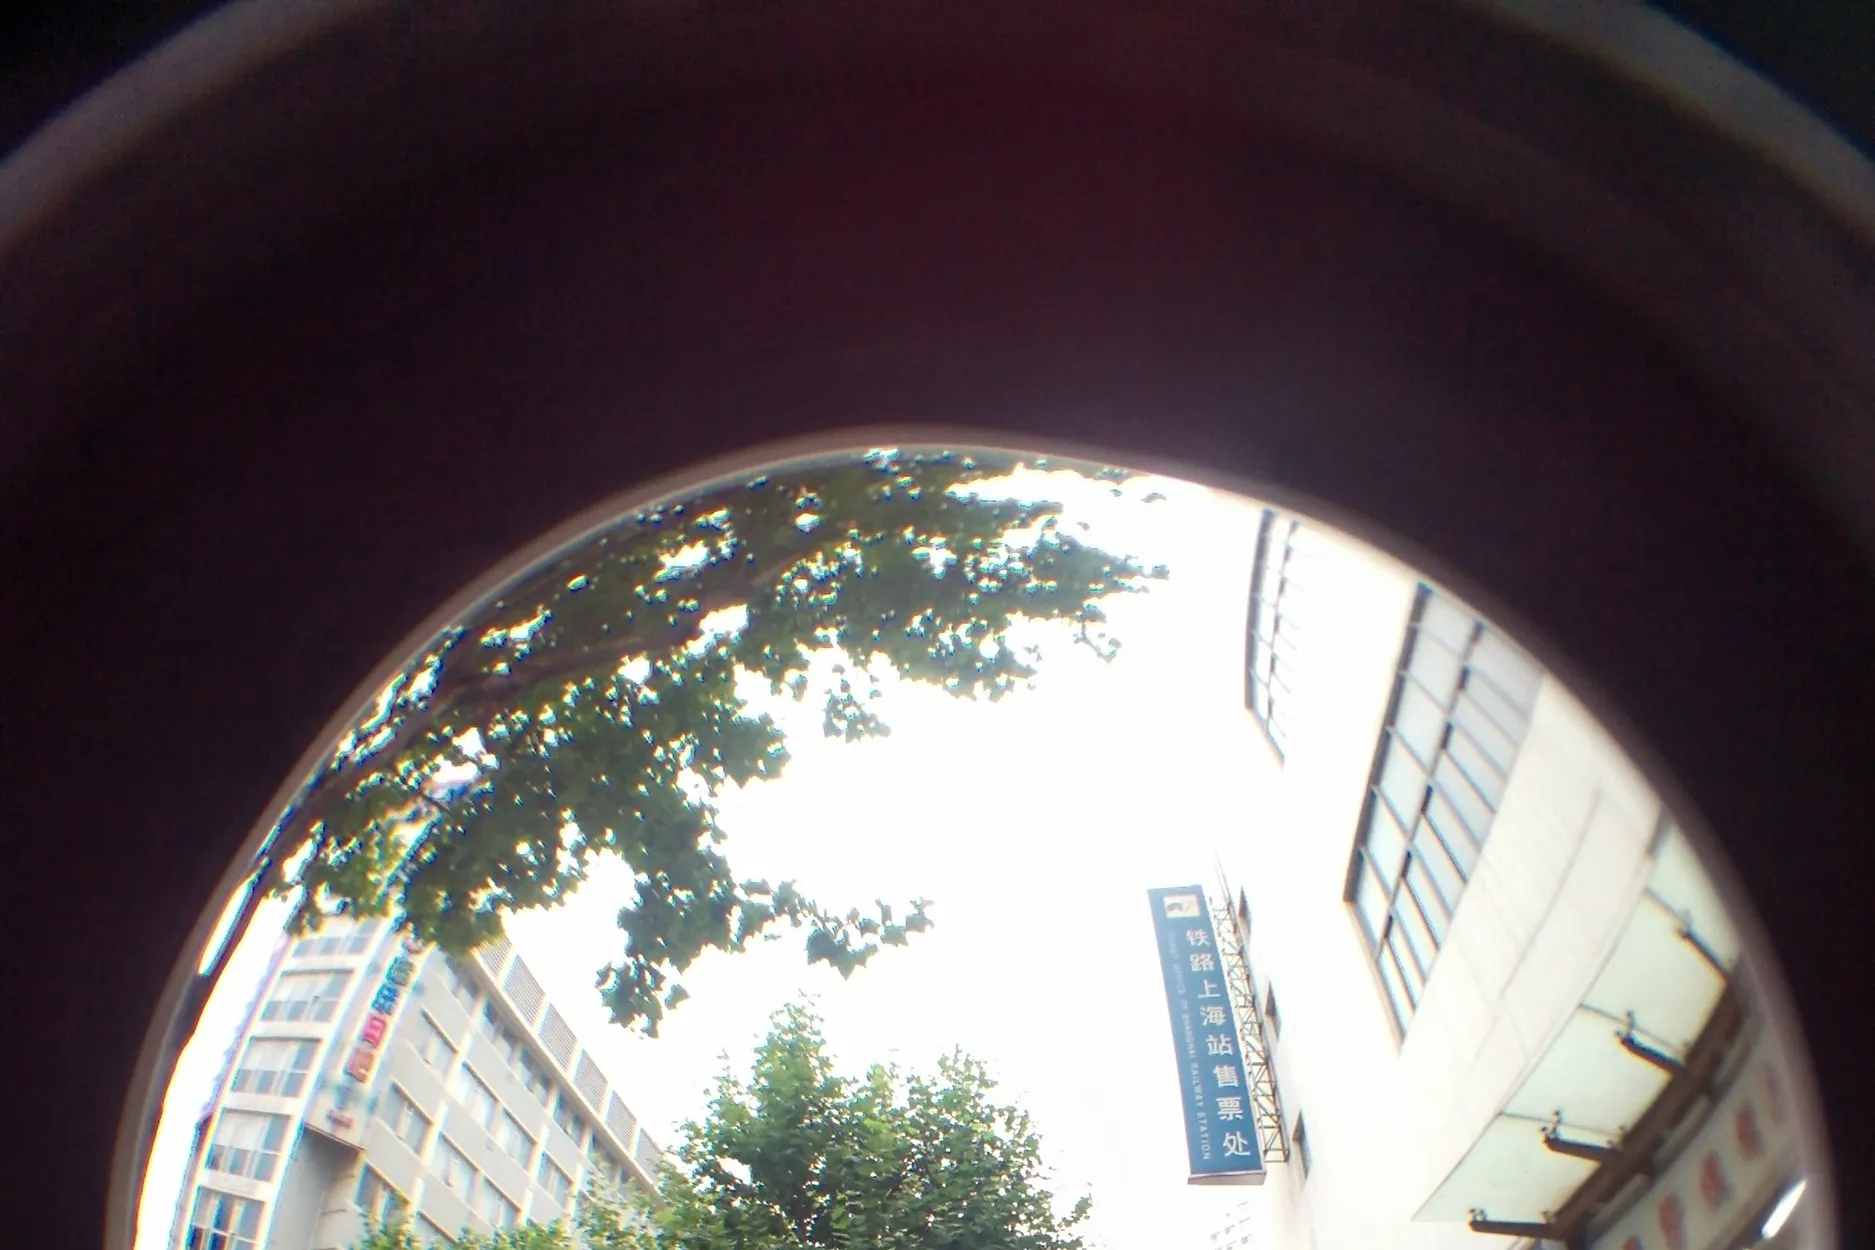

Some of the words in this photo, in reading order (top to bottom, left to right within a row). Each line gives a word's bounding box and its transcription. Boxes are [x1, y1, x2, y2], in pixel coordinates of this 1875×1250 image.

[1182, 1013, 1196, 1058] SHANGHAI
[1191, 1062, 1203, 1107] RAILWAY
[1197, 1111, 1211, 1160] STATION
[1186, 928, 1250, 1158] 铁路上海站售票处
